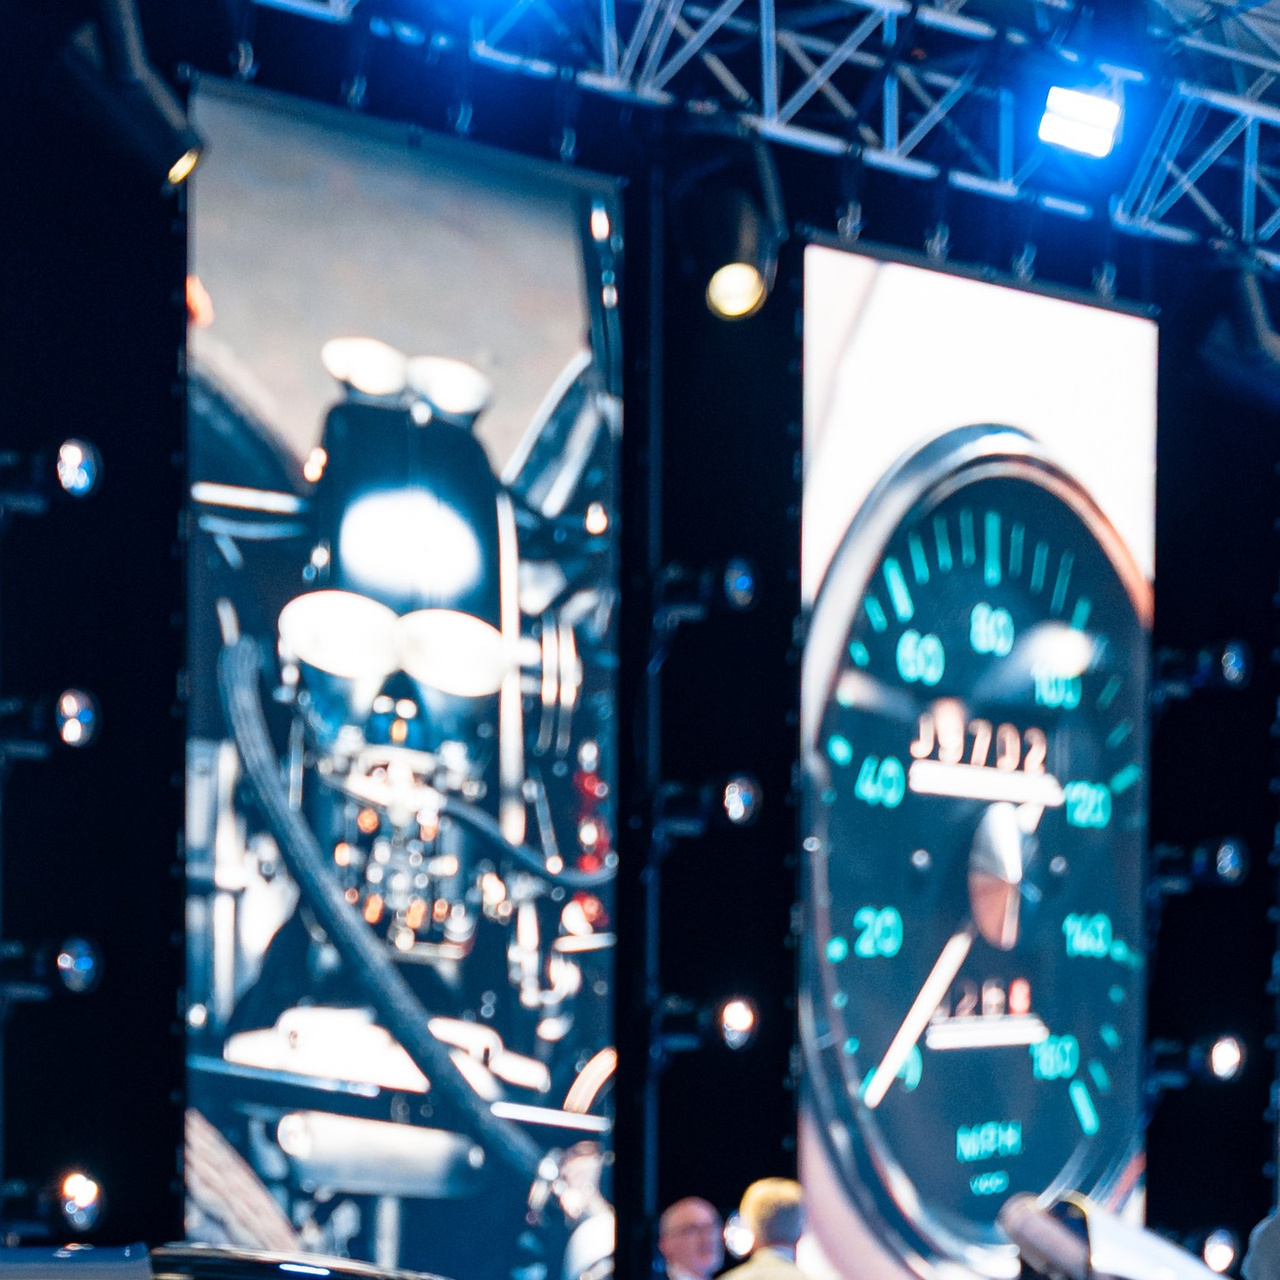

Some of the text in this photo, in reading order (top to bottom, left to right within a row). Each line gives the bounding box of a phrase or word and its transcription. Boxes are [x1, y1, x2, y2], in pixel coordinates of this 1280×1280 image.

[970, 601, 1015, 656] 80
[896, 629, 945, 686] 60
[855, 755, 905, 808] 40
[853, 906, 903, 957] 20
